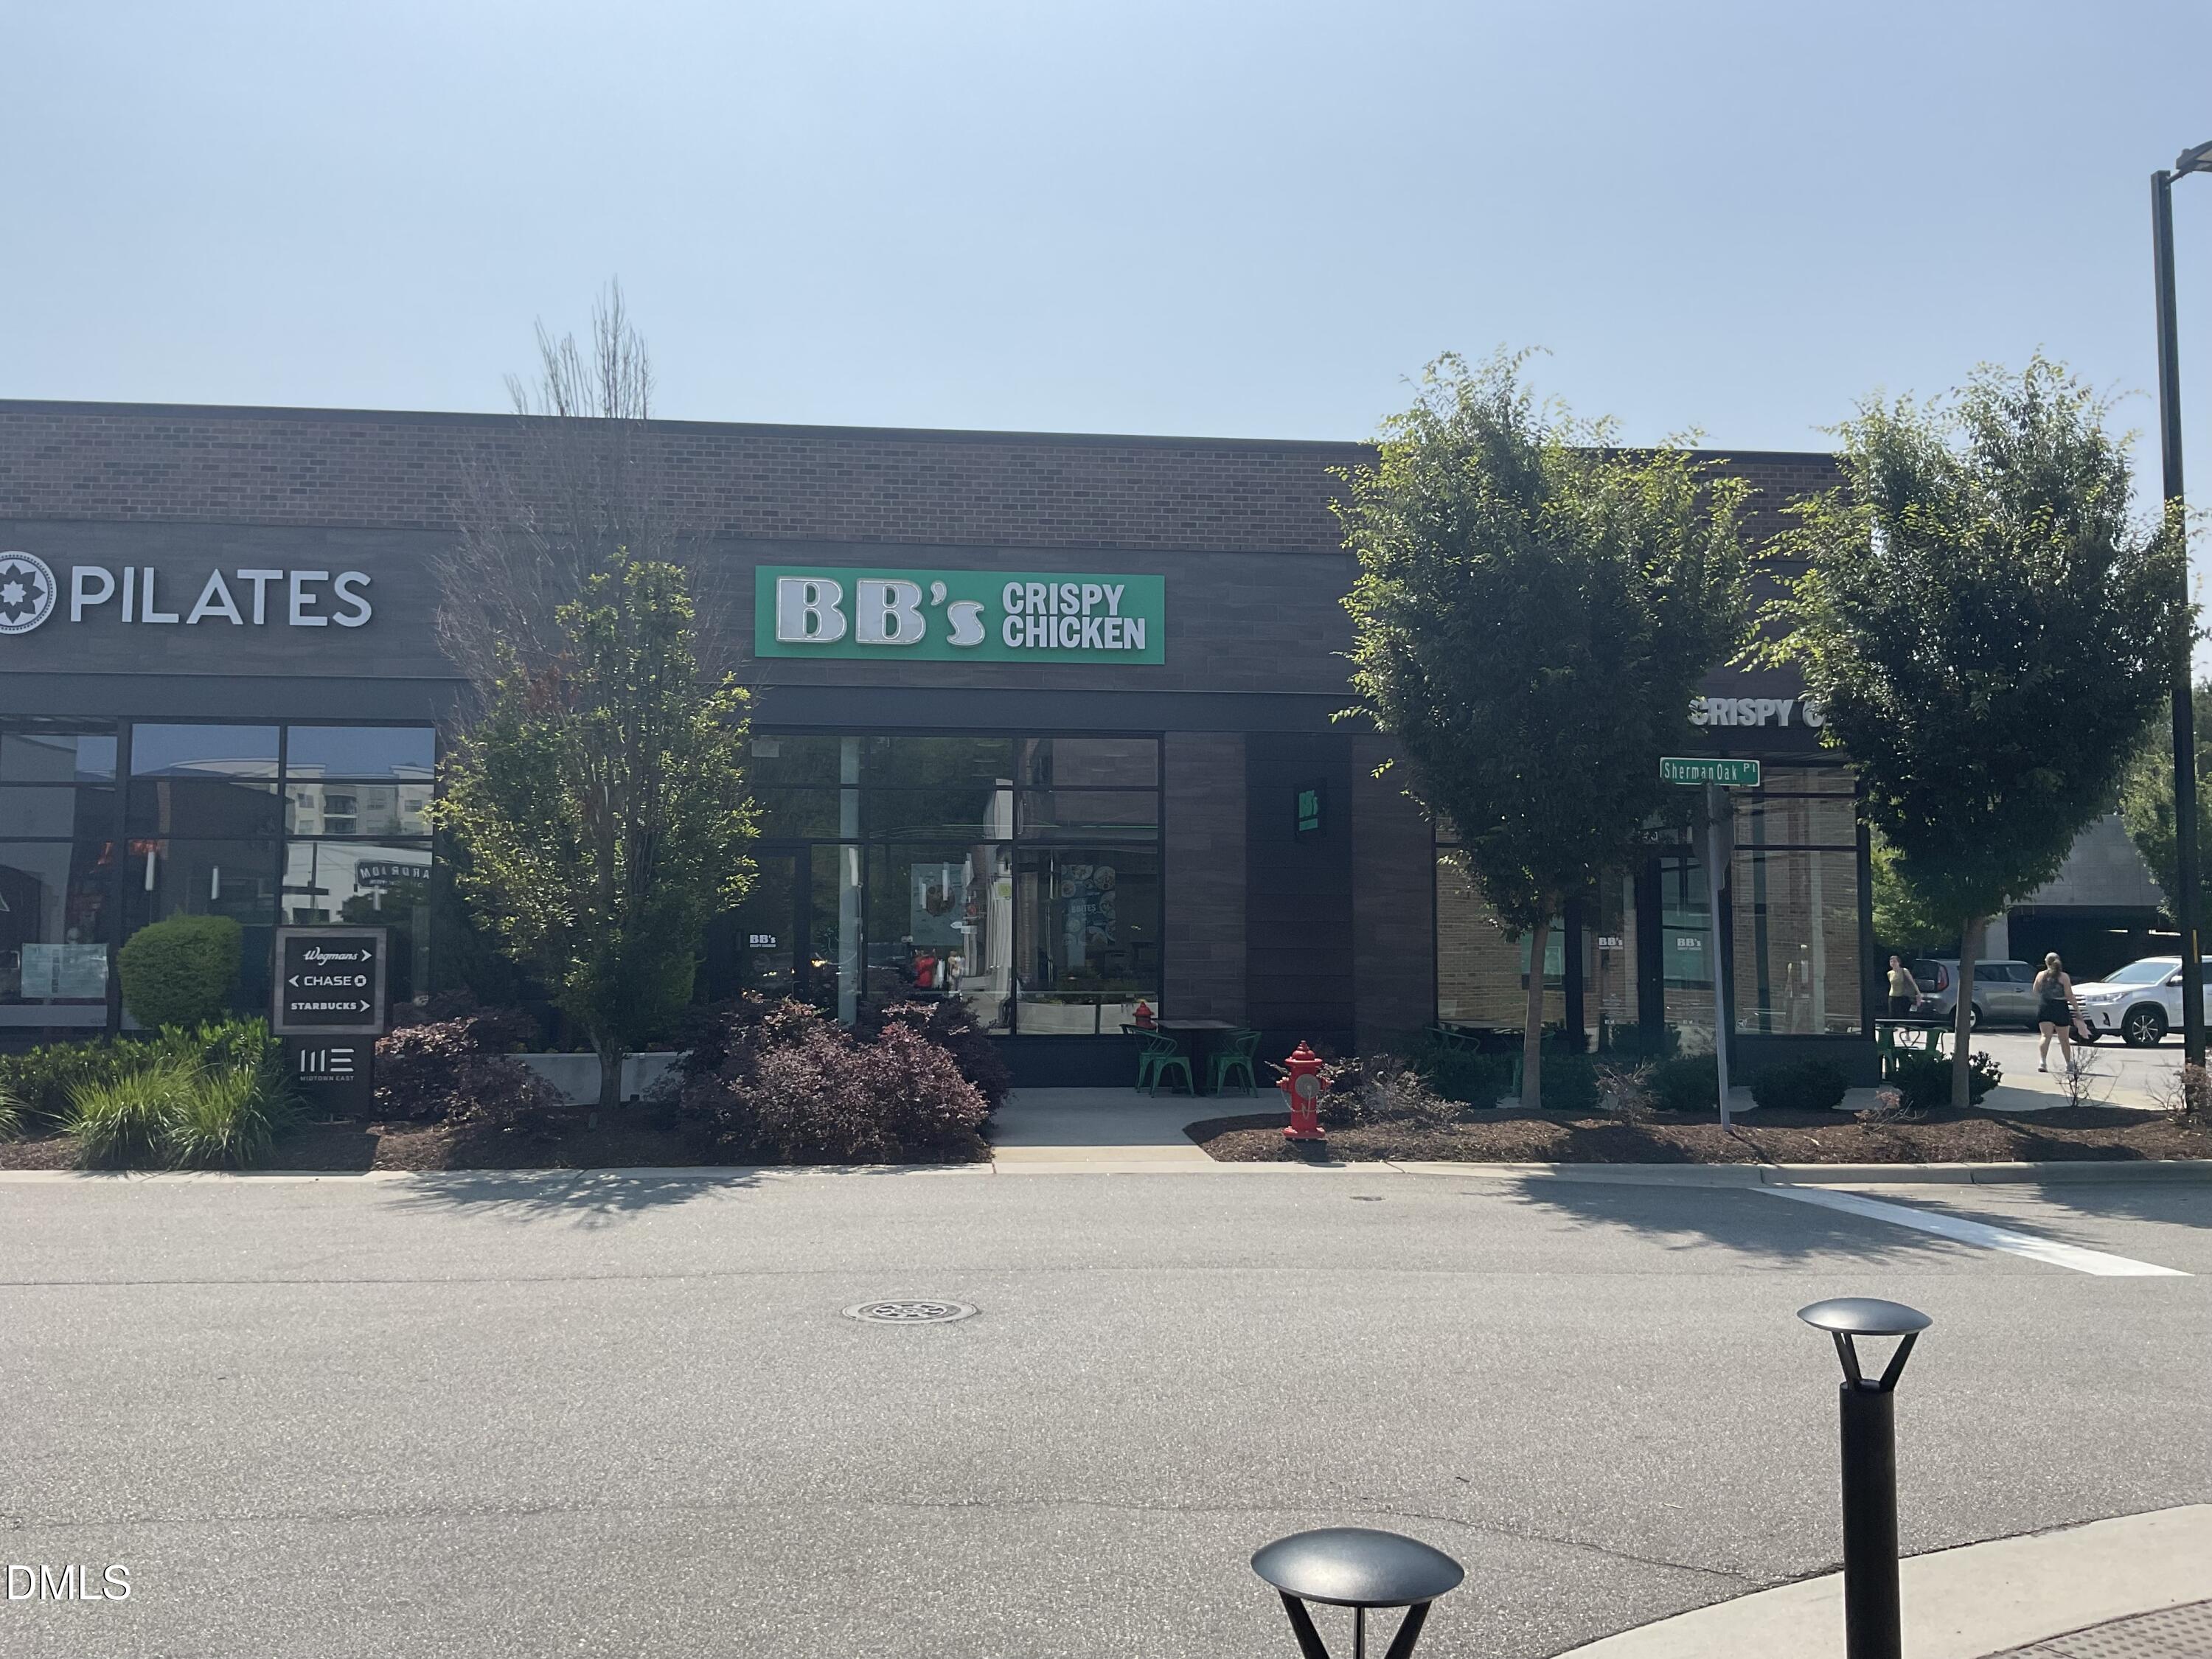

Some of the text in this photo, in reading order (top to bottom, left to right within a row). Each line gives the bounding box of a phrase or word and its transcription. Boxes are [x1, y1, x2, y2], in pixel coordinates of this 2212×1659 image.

[70, 566, 372, 627] PILATES
[1002, 582, 1125, 616] CRISPY
[776, 575, 987, 647] BB's
[1002, 615, 1147, 650] CHICKEN
[1688, 698, 1795, 726] CRISPY
[1664, 762, 1714, 779] Sherman
[1717, 763, 1737, 780] Oak
[749, 934, 776, 944] BB's
[302, 947, 358, 966] Wegmans
[304, 975, 352, 987] CHASE
[291, 1002, 357, 1010] STARBUCKS
